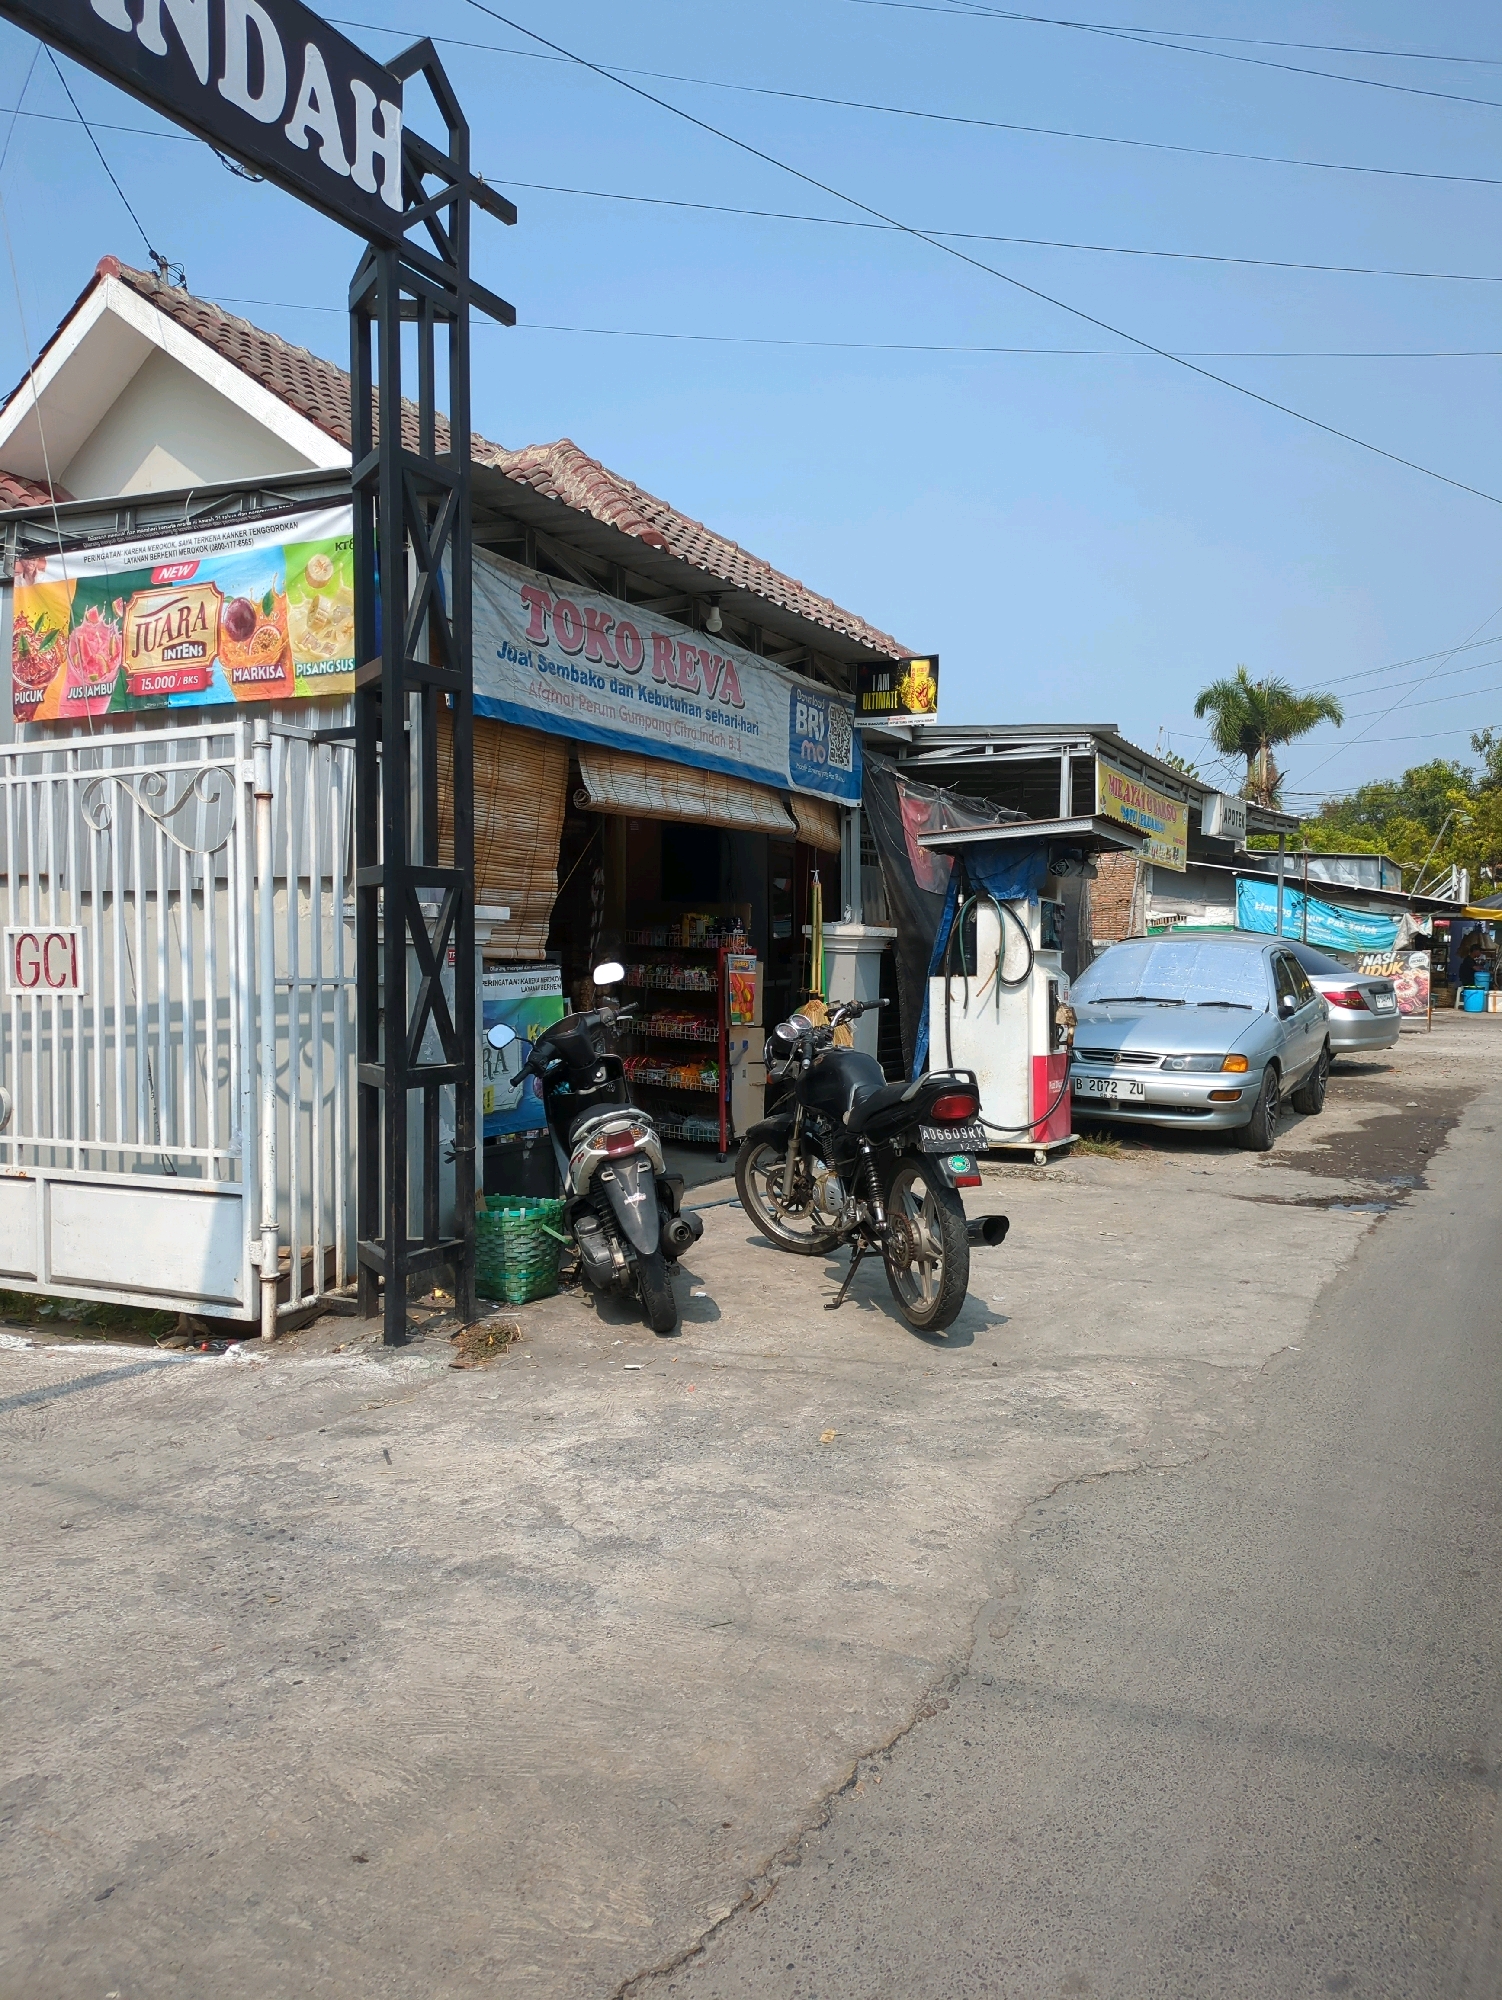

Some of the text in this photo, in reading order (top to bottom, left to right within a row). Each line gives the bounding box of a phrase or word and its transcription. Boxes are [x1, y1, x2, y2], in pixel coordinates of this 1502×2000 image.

[88, 0, 402, 212] NDAH
[124, 547, 146, 556] KARENA
[194, 534, 221, 544] TERKENA
[222, 530, 247, 540] KANKER
[249, 521, 298, 536] TENGGOROKAN
[124, 555, 148, 565] LAYANAN
[150, 549, 178, 560] BERHENTI
[179, 544, 208, 557] MEROKOK
[158, 563, 193, 579] NEW
[131, 601, 209, 658] JUARA
[520, 584, 746, 709] TOKO REVA
[233, 665, 285, 682] MARKISA
[296, 661, 334, 676] PISANG
[67, 682, 115, 699] JUS JAMBU
[497, 640, 759, 735] Jual Sembako dan Kebutuhan sehari-hari
[877, 673, 890, 691] AM
[14, 689, 44, 705] PUCUK
[796, 689, 825, 709] Download
[862, 690, 898, 710] ULTIMATE
[578, 692, 616, 719] Perum
[619, 705, 672, 737] Gumpang
[674, 720, 697, 741] Citra
[795, 702, 825, 741] BRI
[801, 739, 826, 764] mo
[1223, 807, 1246, 830] APOTEK
[1294, 909, 1325, 923] Syur
[15, 933, 78, 989] GCI
[1358, 961, 1404, 977] UDUK
[1362, 952, 1397, 967] NASI
[1076, 1078, 1083, 1090] B
[1089, 1079, 1118, 1094] 2072
[1129, 1082, 1144, 1095] ZU
